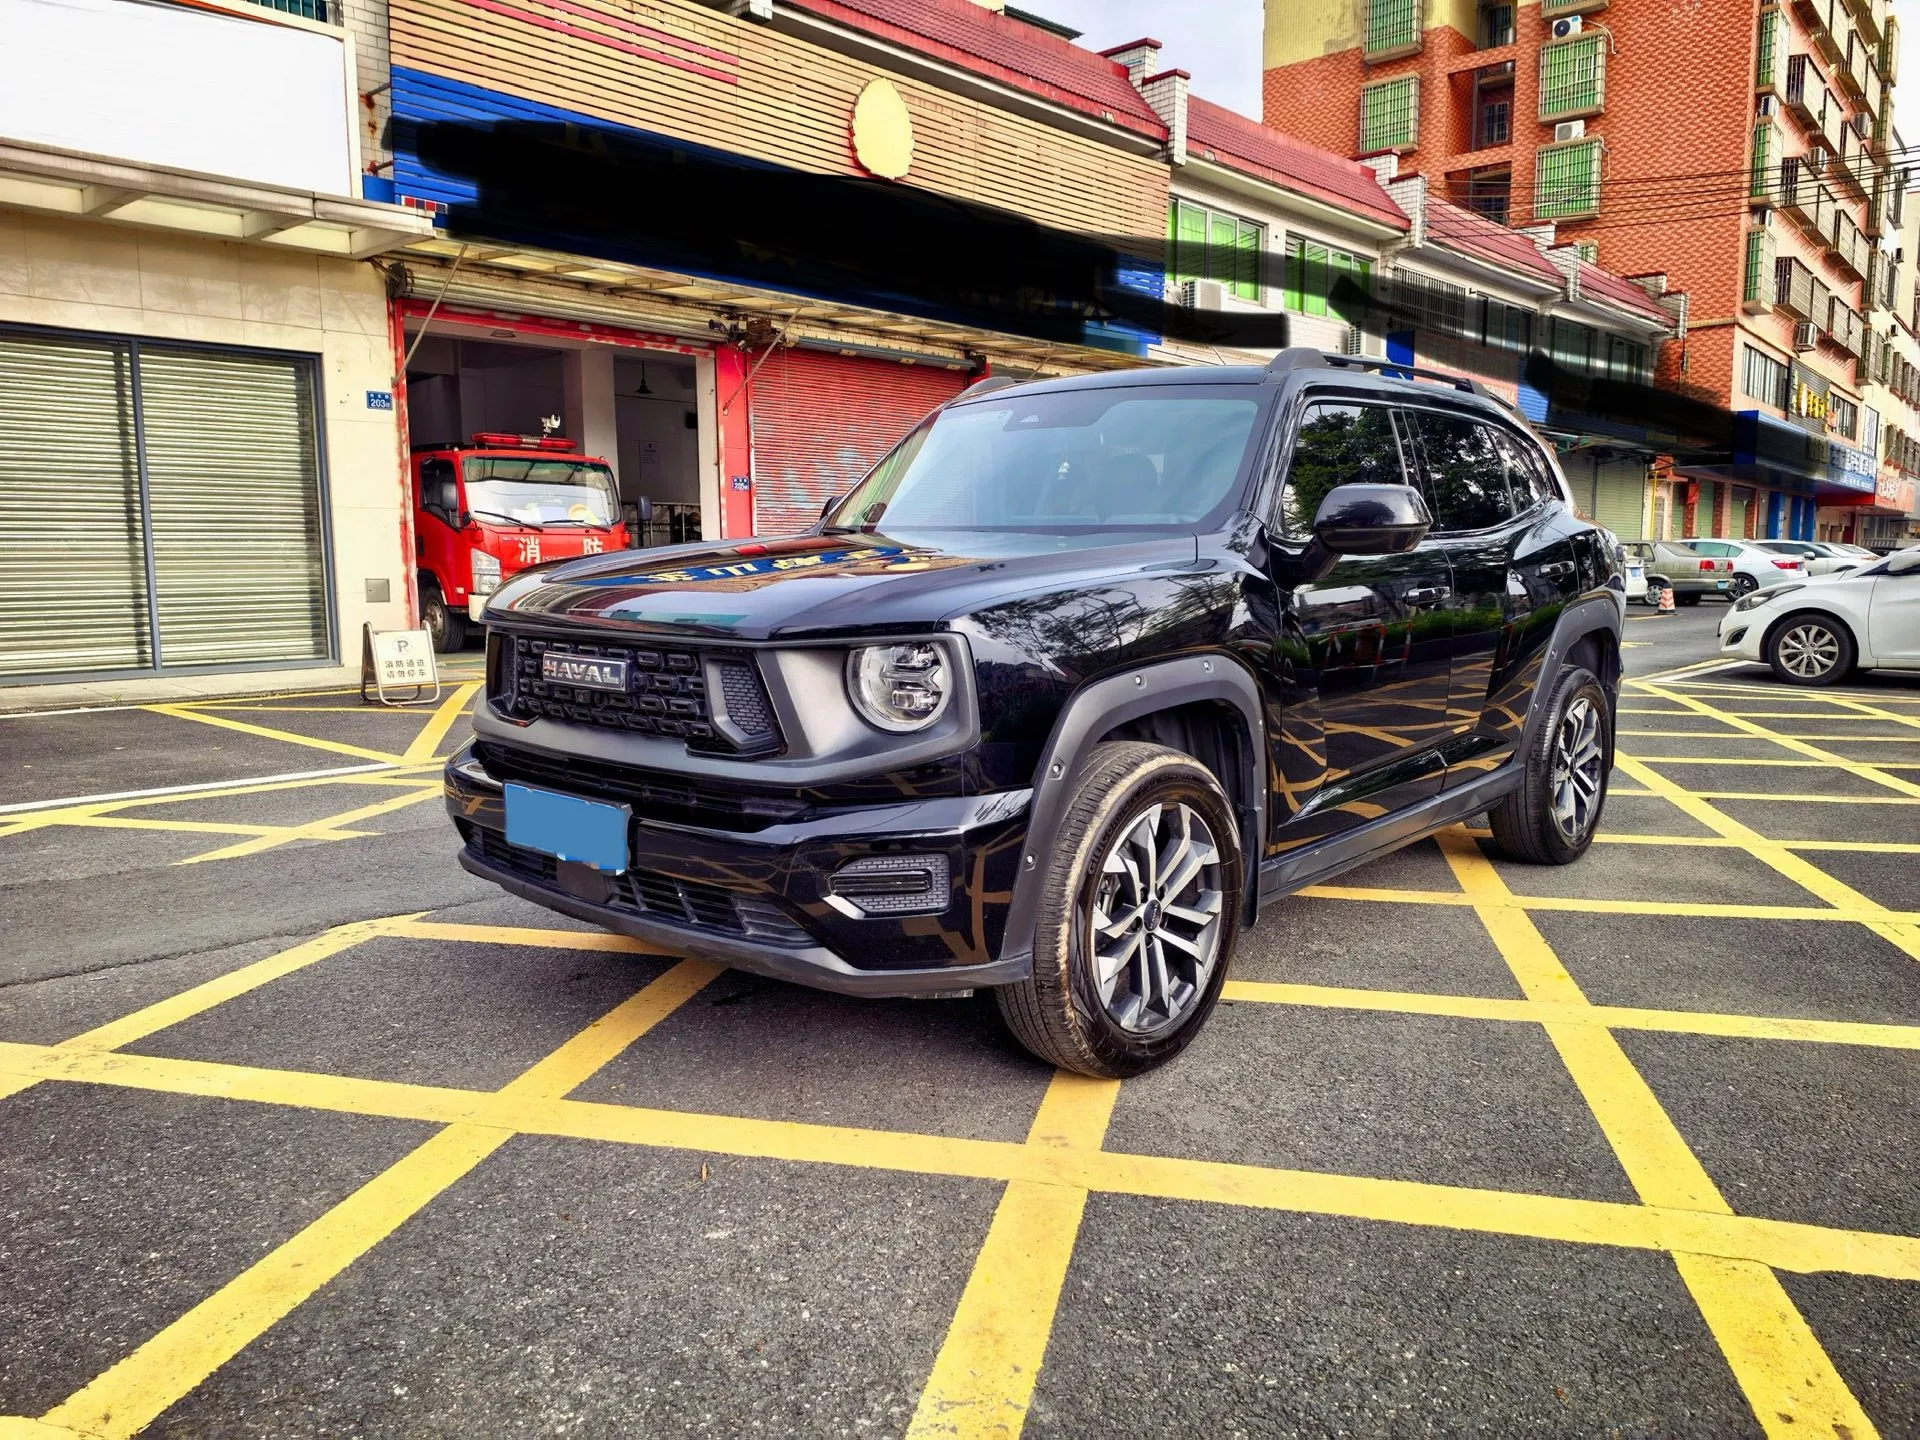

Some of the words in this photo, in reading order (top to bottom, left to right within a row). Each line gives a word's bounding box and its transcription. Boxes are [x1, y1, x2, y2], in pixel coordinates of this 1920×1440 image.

[370, 398, 390, 408] 203
[384, 659, 425, 668] 消防通道
[386, 669, 427, 679] 请勿停车
[543, 659, 620, 685] HAVAL
